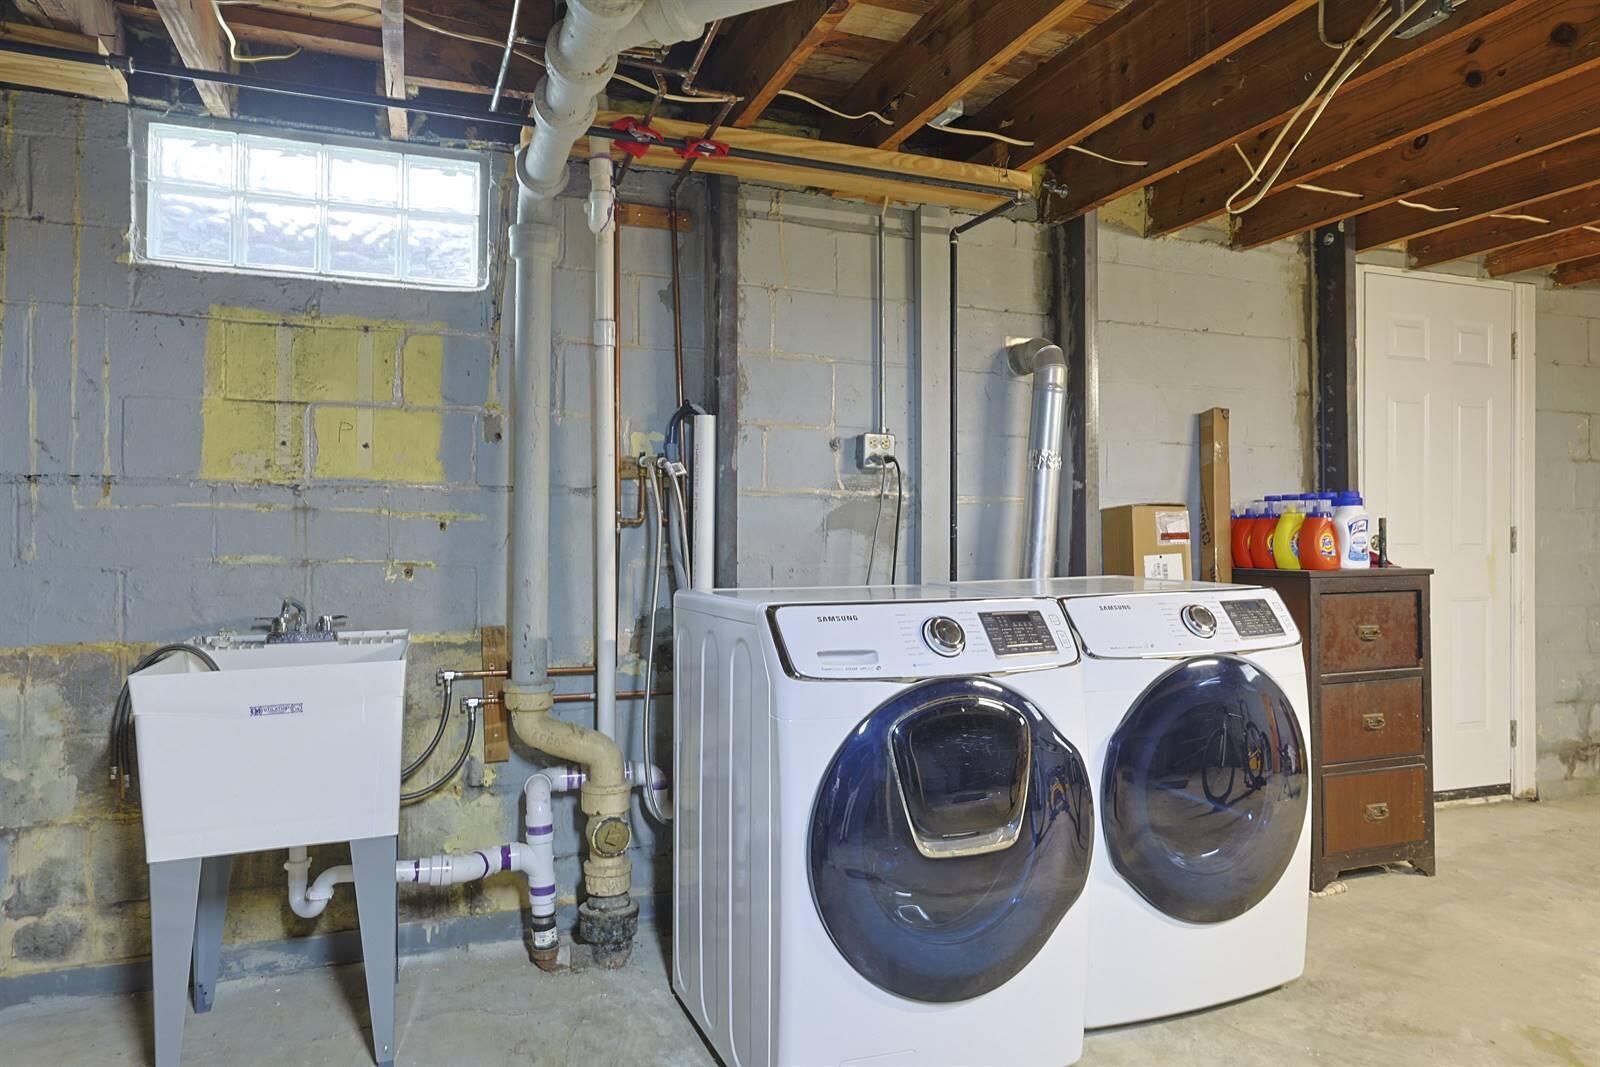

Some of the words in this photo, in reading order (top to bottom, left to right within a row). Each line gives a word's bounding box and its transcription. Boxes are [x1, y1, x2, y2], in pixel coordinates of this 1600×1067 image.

[338, 421, 354, 443] P
[1098, 604, 1131, 612] SAMSUNG
[816, 614, 858, 623] SAMSUNG
